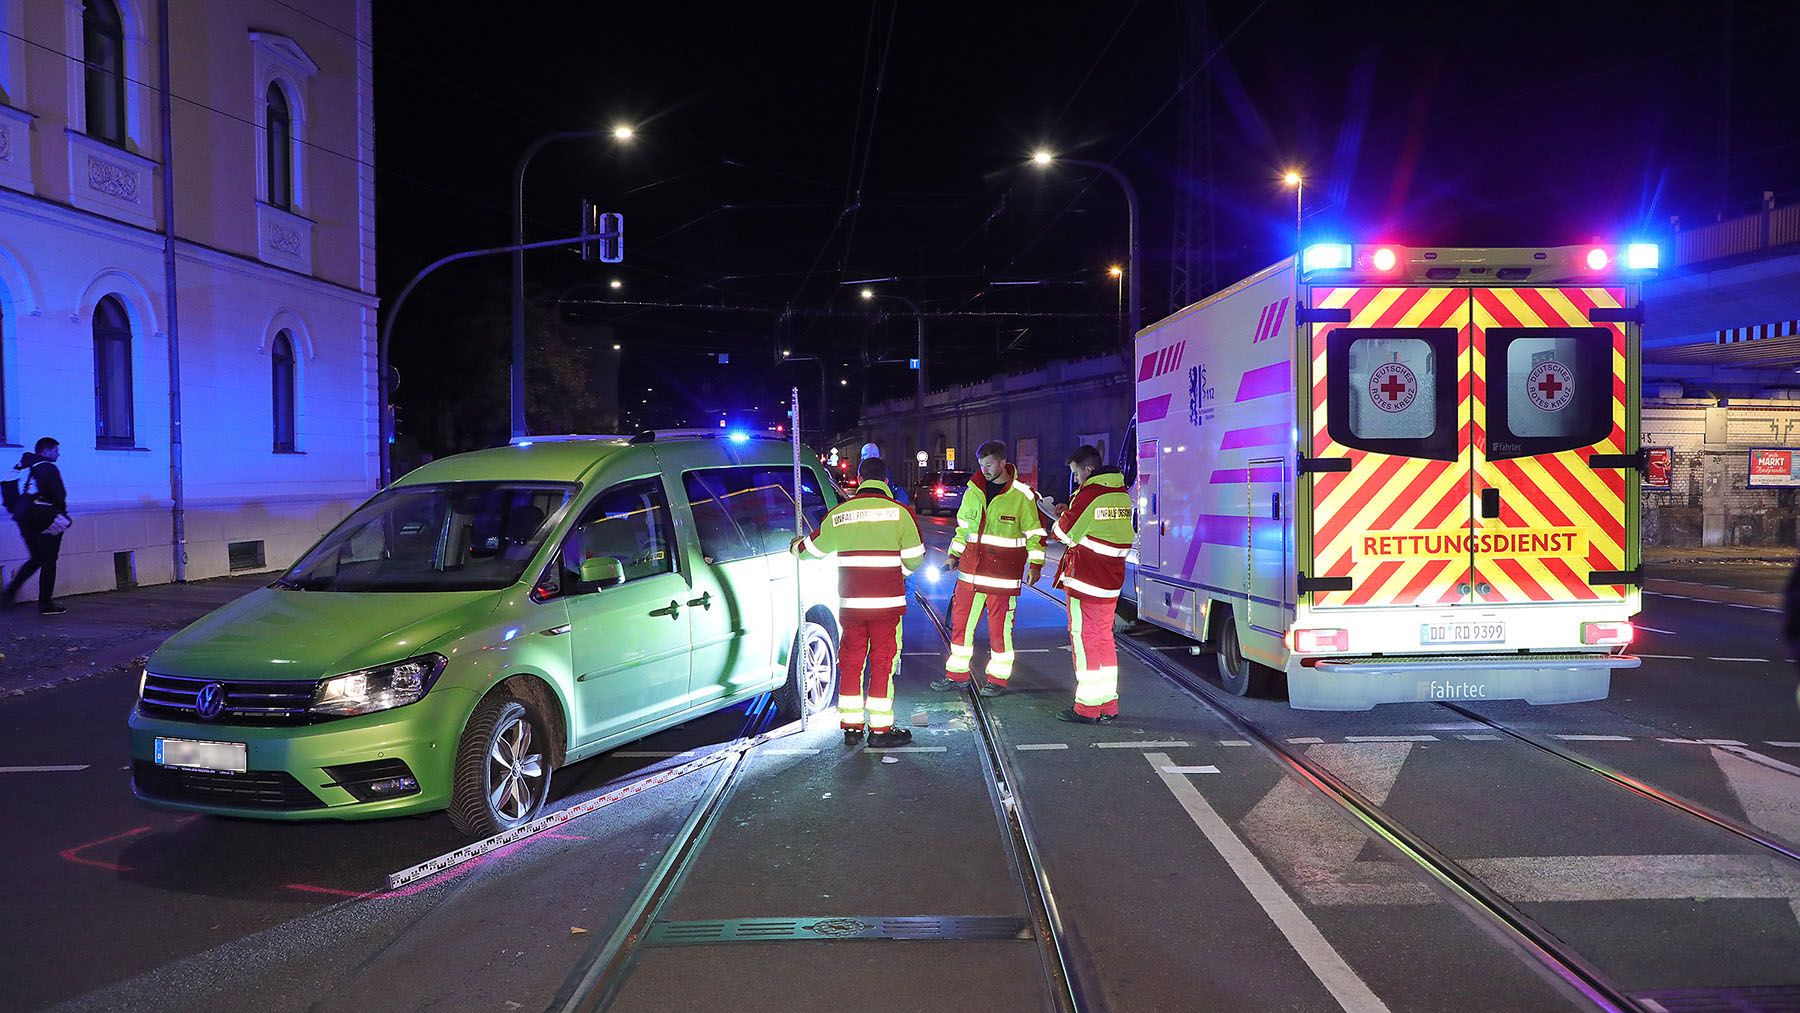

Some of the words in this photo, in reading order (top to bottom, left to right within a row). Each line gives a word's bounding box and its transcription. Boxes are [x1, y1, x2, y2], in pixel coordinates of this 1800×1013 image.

[1372, 365, 1413, 384] DEUTSCHES
[1530, 364, 1570, 383] DEUTSCHES
[1206, 388, 1214, 400] 112
[1372, 388, 1392, 410] ROTES
[1394, 388, 1415, 410] KREUZ
[1529, 387, 1549, 408] ROTES
[1551, 387, 1571, 408] KREUZ
[1499, 442, 1521, 451] fahrtec
[1758, 457, 1785, 466] MARKT
[1363, 533, 1578, 556] RETTUNGSDIENST
[1430, 626, 1446, 640] DD
[1455, 625, 1470, 640] RD
[1473, 625, 1503, 639] 9399
[1430, 680, 1486, 698] fahrtec
